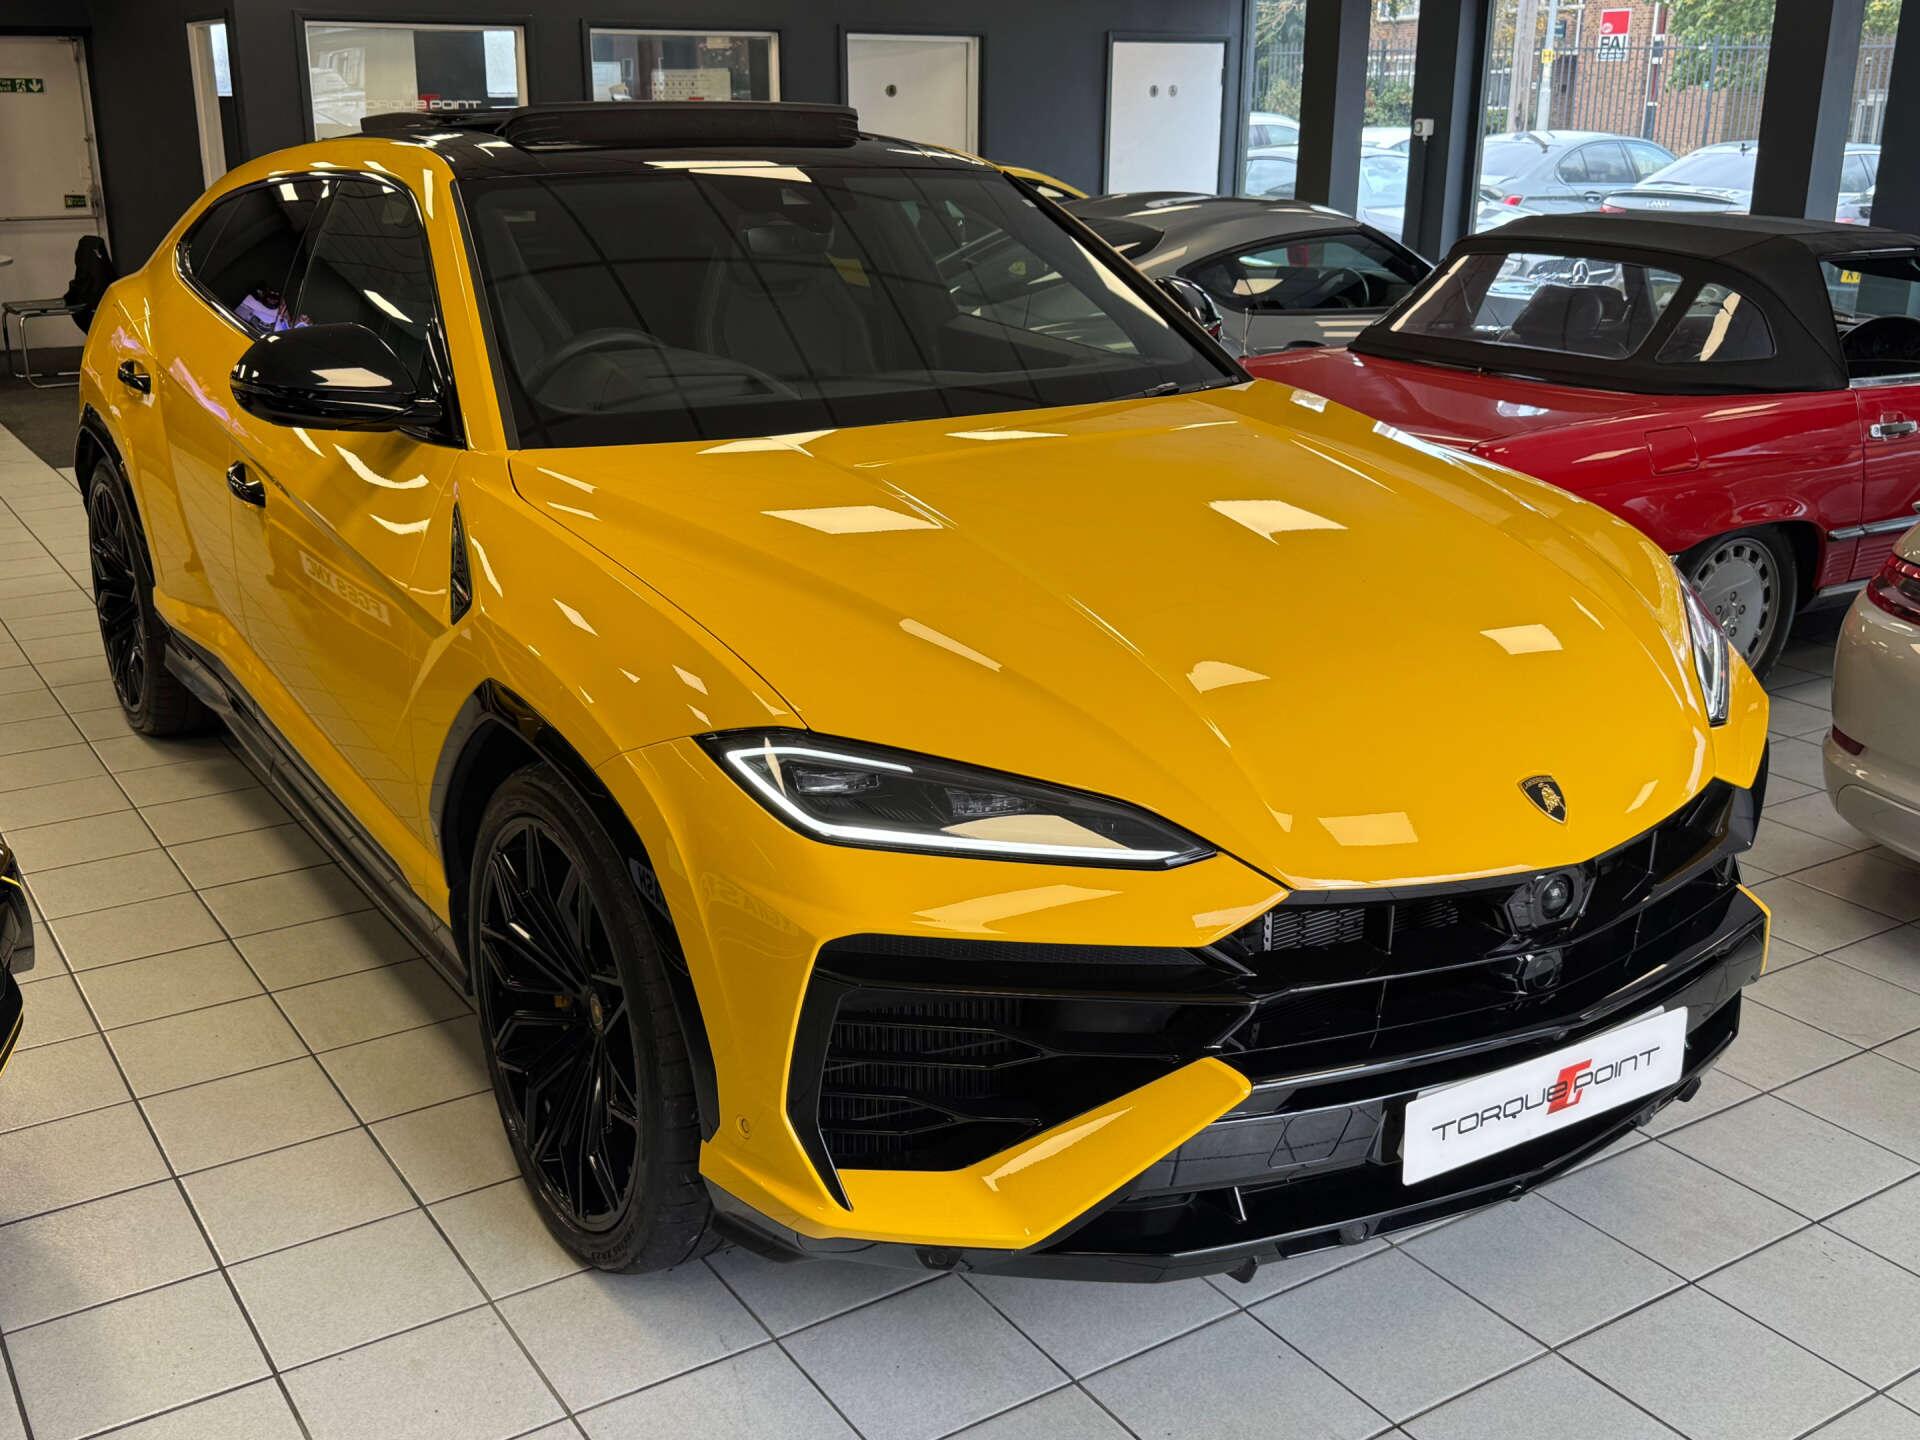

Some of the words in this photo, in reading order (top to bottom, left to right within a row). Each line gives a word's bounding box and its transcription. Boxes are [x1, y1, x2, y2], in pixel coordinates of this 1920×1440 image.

[429, 99, 482, 110] POINT
[1431, 1079, 1568, 1141] TORQUE
[1573, 1046, 1661, 1094] POINT
